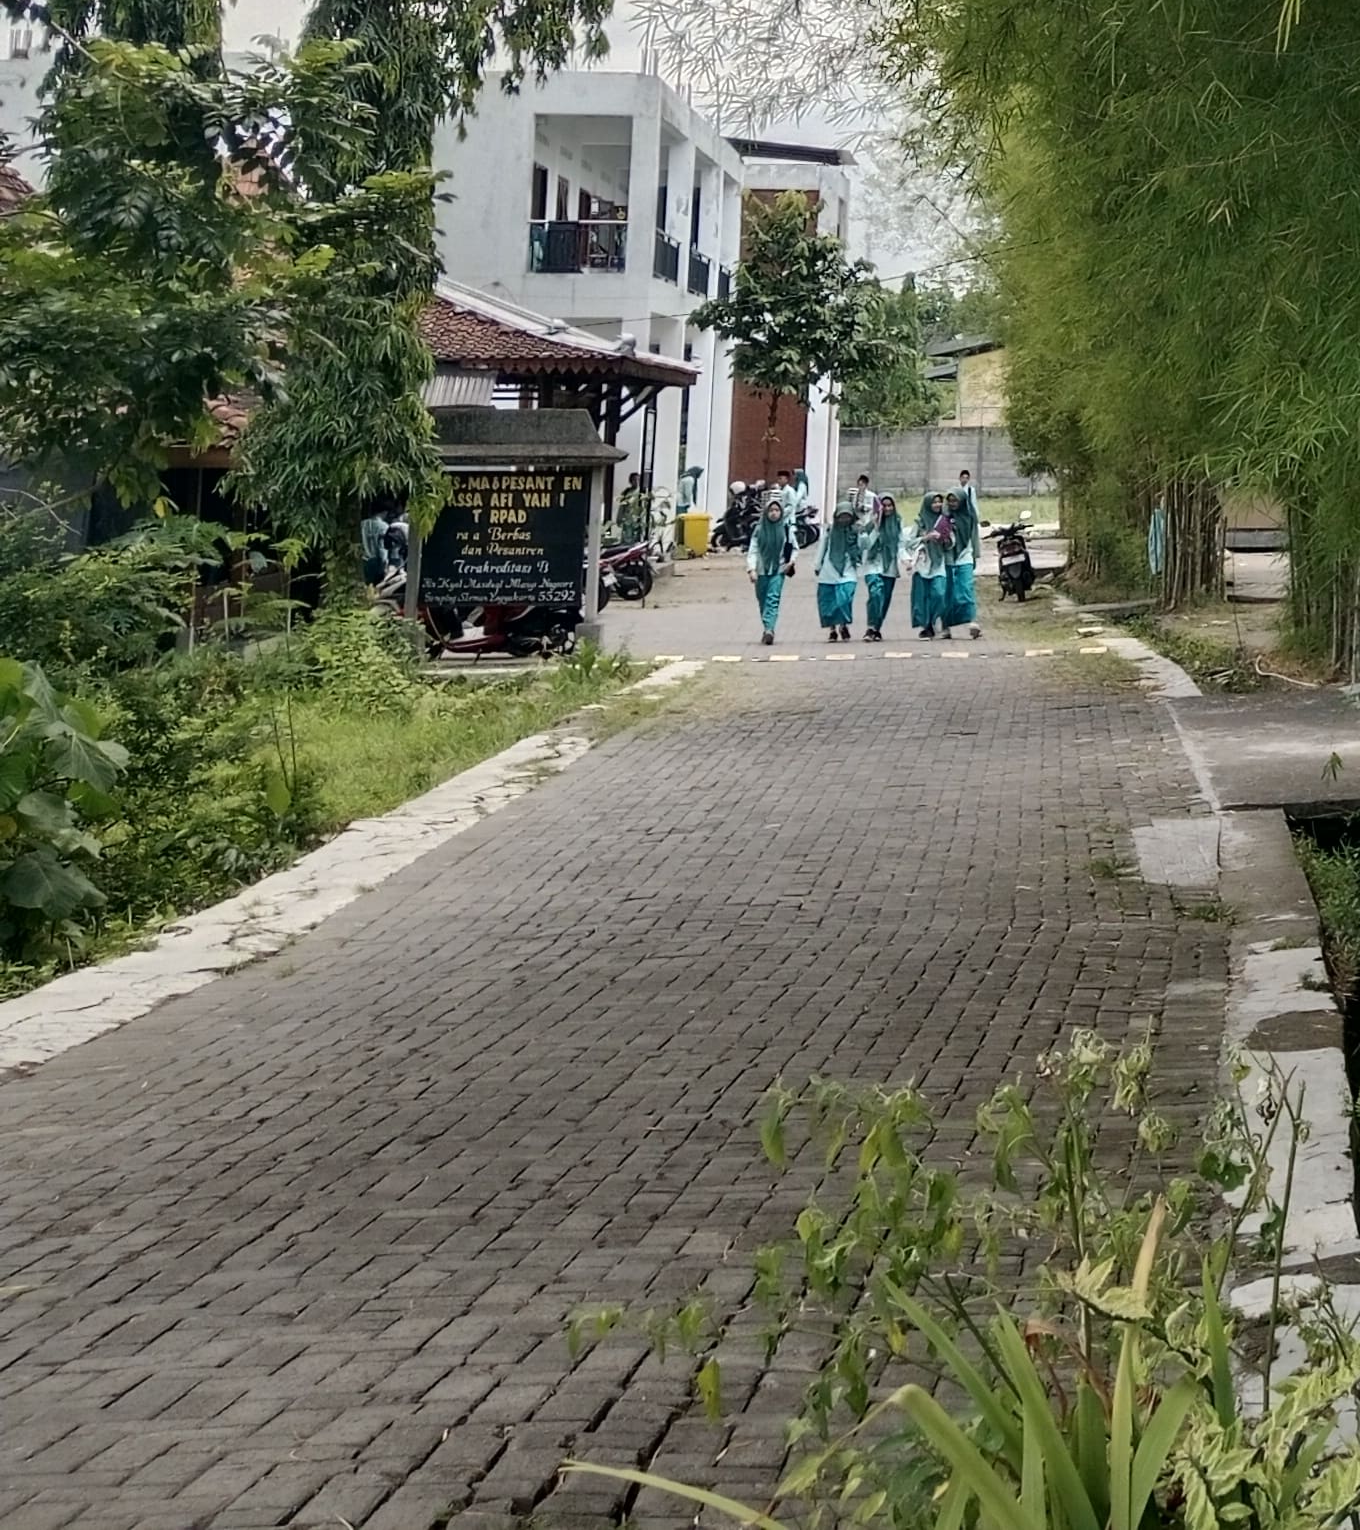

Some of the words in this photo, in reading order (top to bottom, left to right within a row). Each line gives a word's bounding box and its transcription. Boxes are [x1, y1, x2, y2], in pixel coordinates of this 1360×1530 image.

[502, 476, 582, 491] PESANTEN
[448, 492, 551, 508] ASSAAFIYAH
[461, 544, 482, 556] dan
[486, 542, 545, 556] Pesantren
[538, 590, 576, 602] 55292
